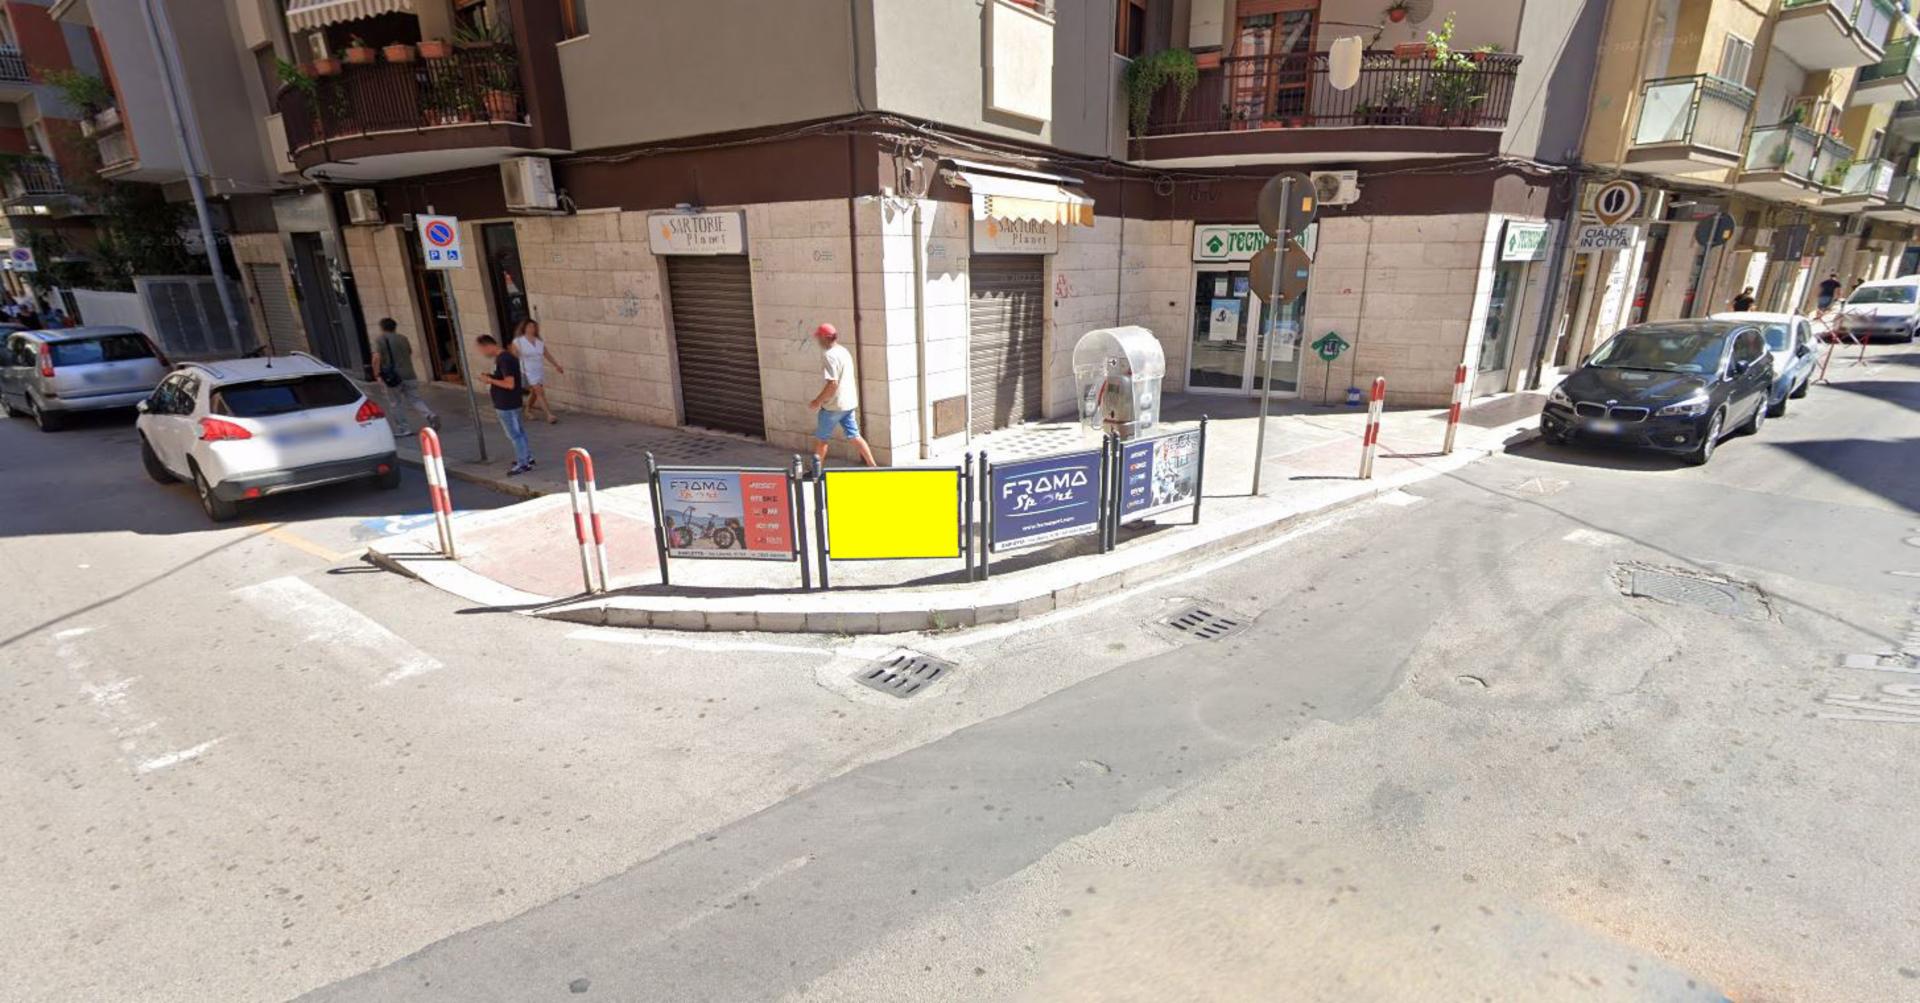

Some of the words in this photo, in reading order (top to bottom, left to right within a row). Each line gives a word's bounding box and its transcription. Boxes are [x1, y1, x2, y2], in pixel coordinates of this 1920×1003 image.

[670, 216, 727, 234] SARTORIE
[1012, 233, 1047, 246] Planet
[1580, 239, 1592, 248] IN
[670, 481, 728, 491] FRAMA
[1003, 471, 1088, 499] FRAMA
